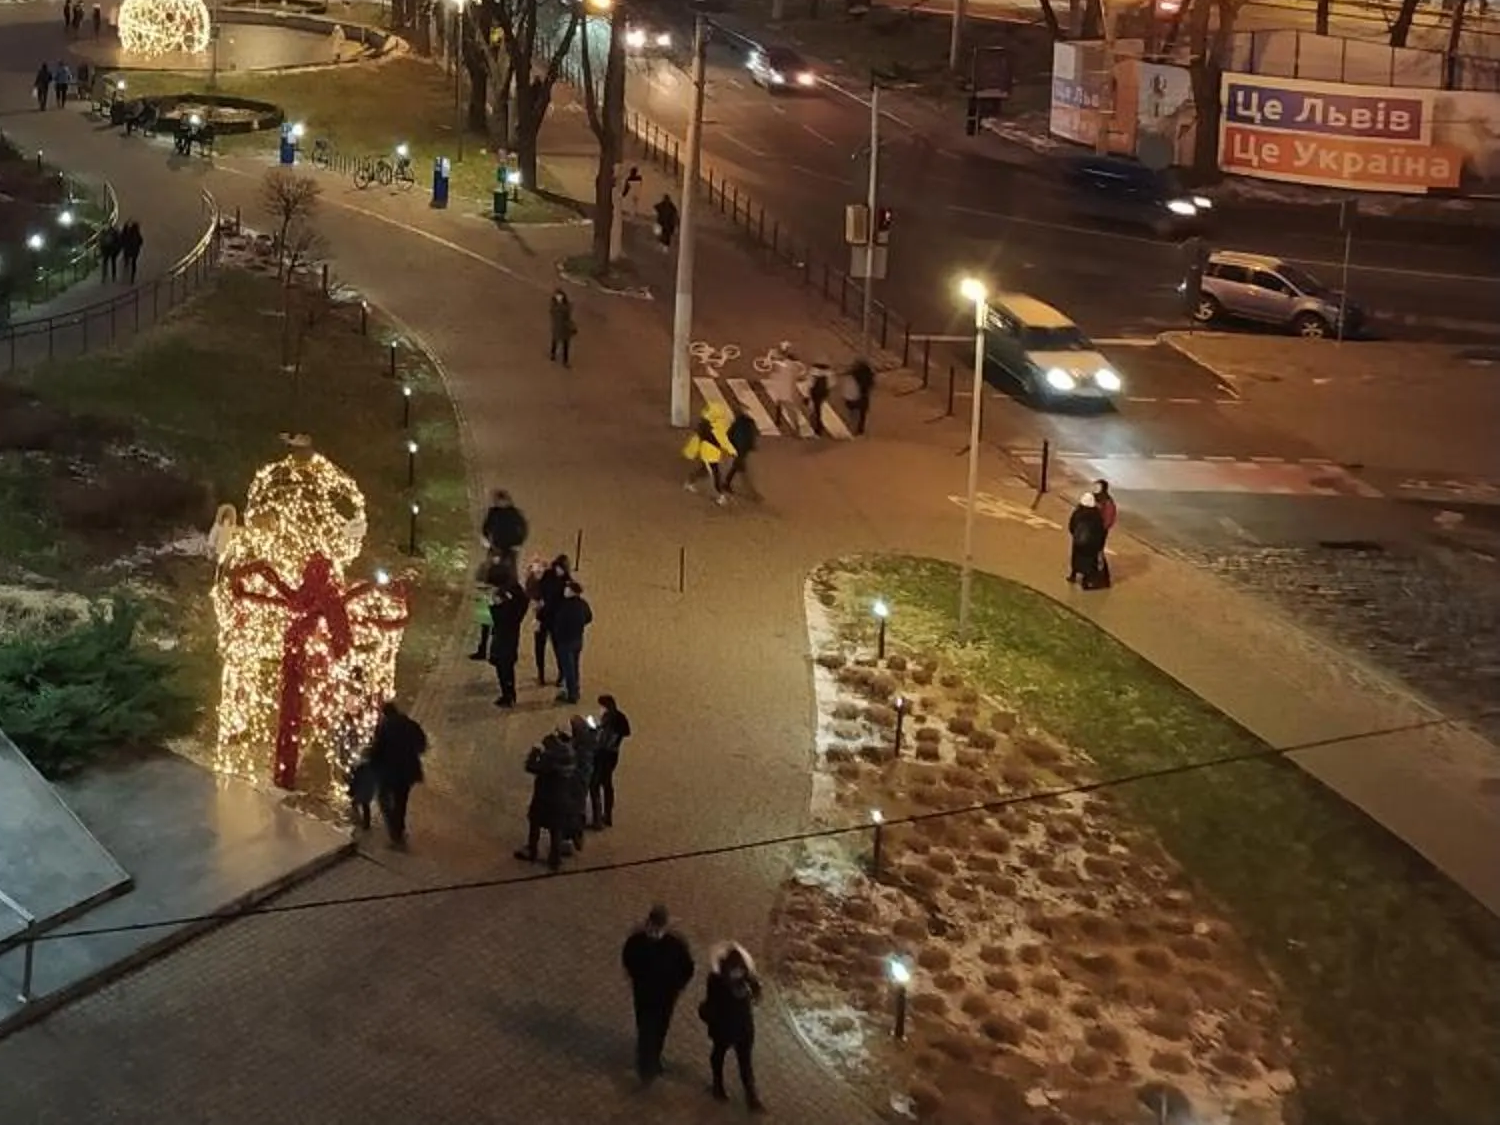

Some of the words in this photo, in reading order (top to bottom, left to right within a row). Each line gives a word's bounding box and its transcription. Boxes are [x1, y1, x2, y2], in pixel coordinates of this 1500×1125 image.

[1236, 90, 1284, 124] Це
[1294, 97, 1411, 132] Львів
[1233, 133, 1281, 167] Це
[1293, 139, 1451, 179] Україна
